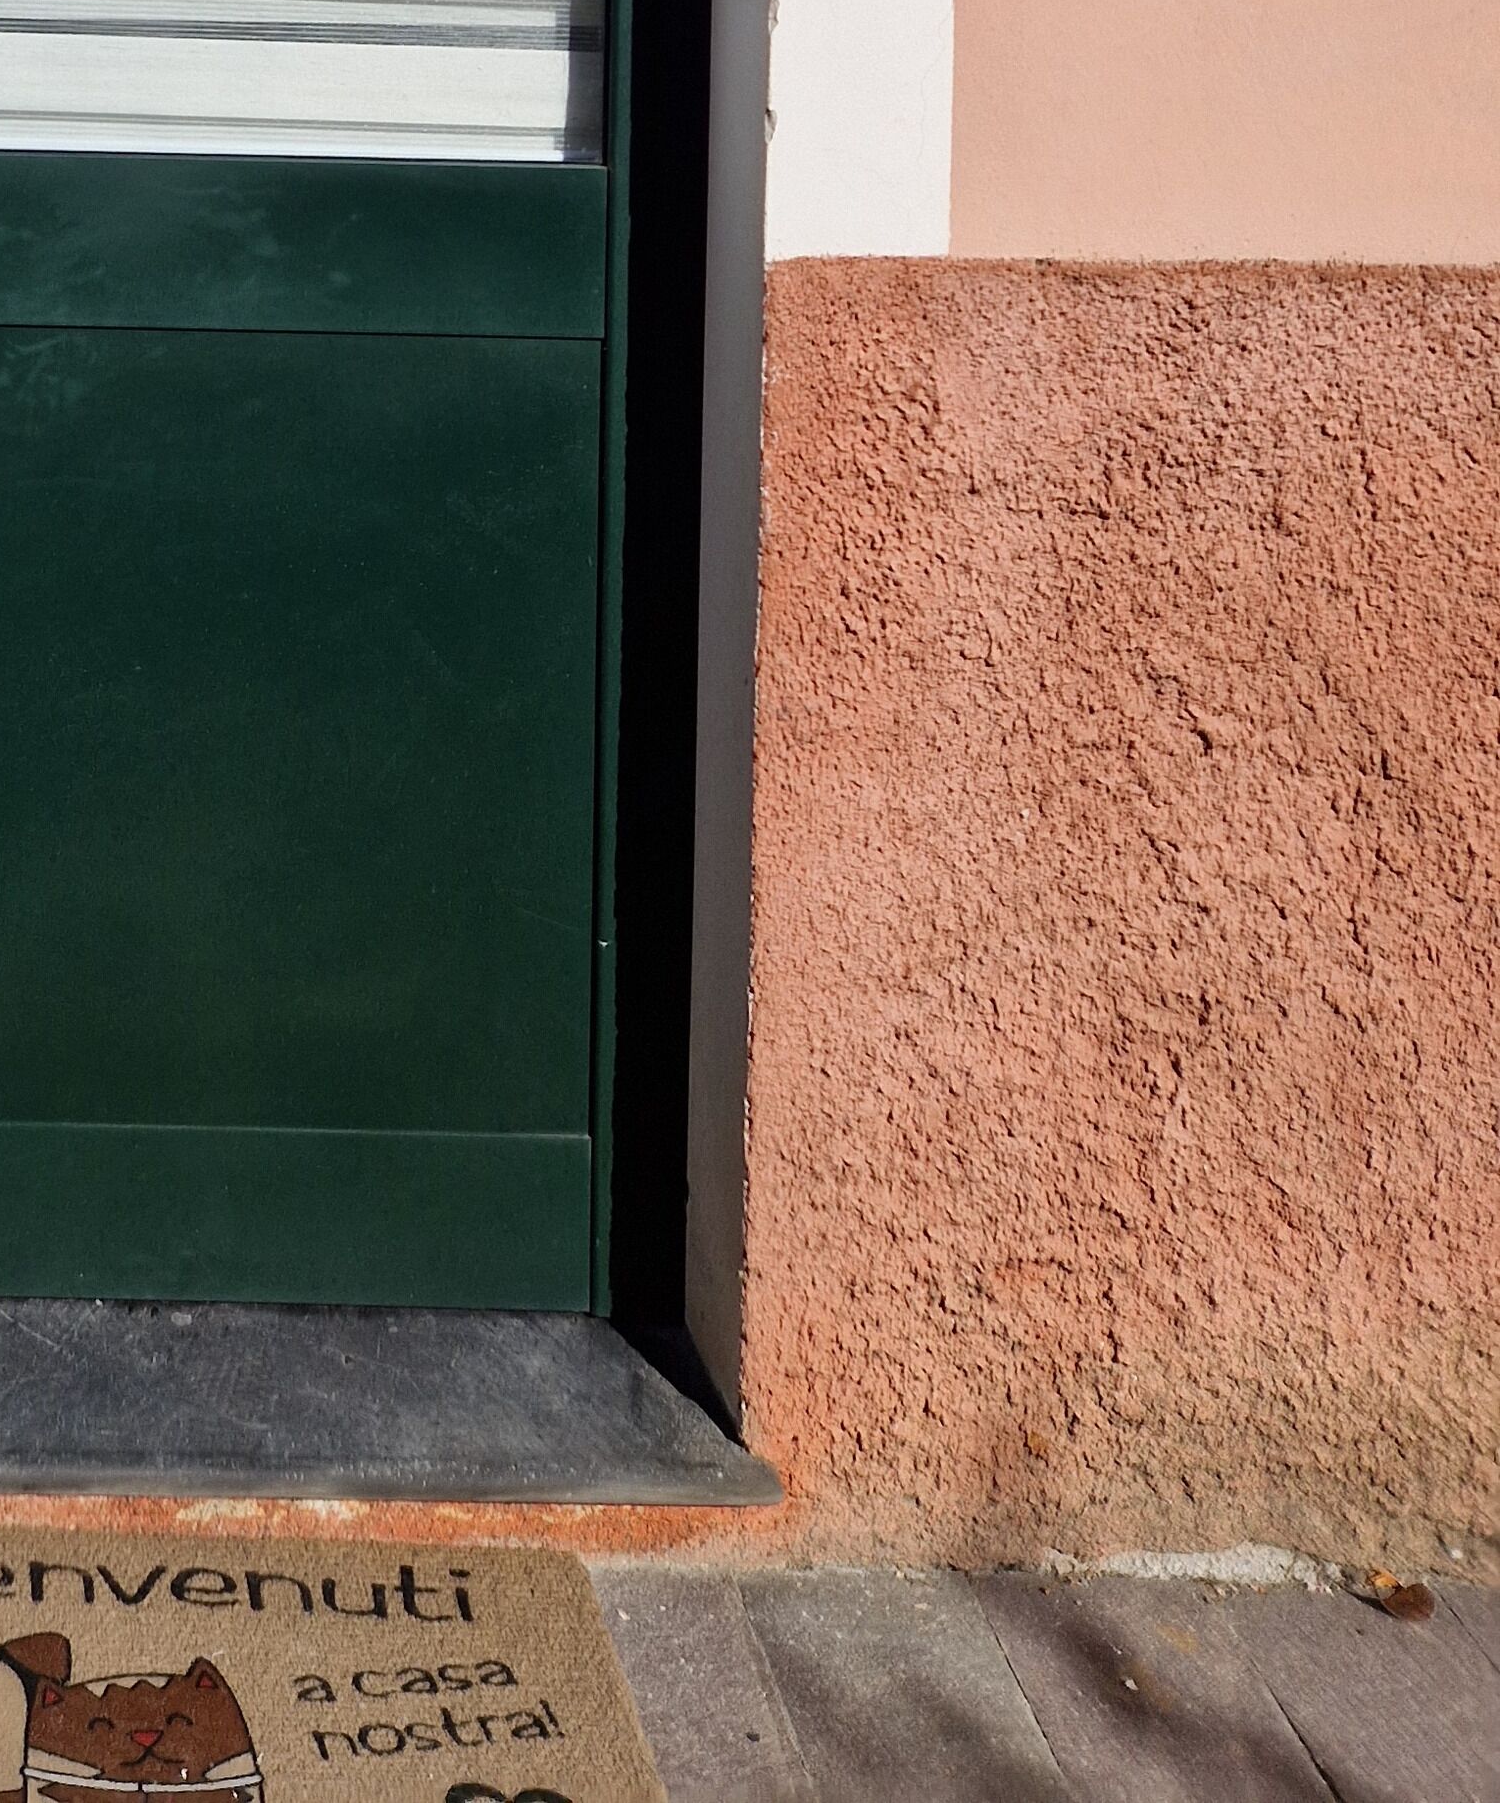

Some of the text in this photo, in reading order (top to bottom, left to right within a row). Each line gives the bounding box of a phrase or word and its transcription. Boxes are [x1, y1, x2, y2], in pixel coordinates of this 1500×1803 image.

[294, 1660, 518, 1702] a casa
[310, 1698, 566, 1761] nostra!
